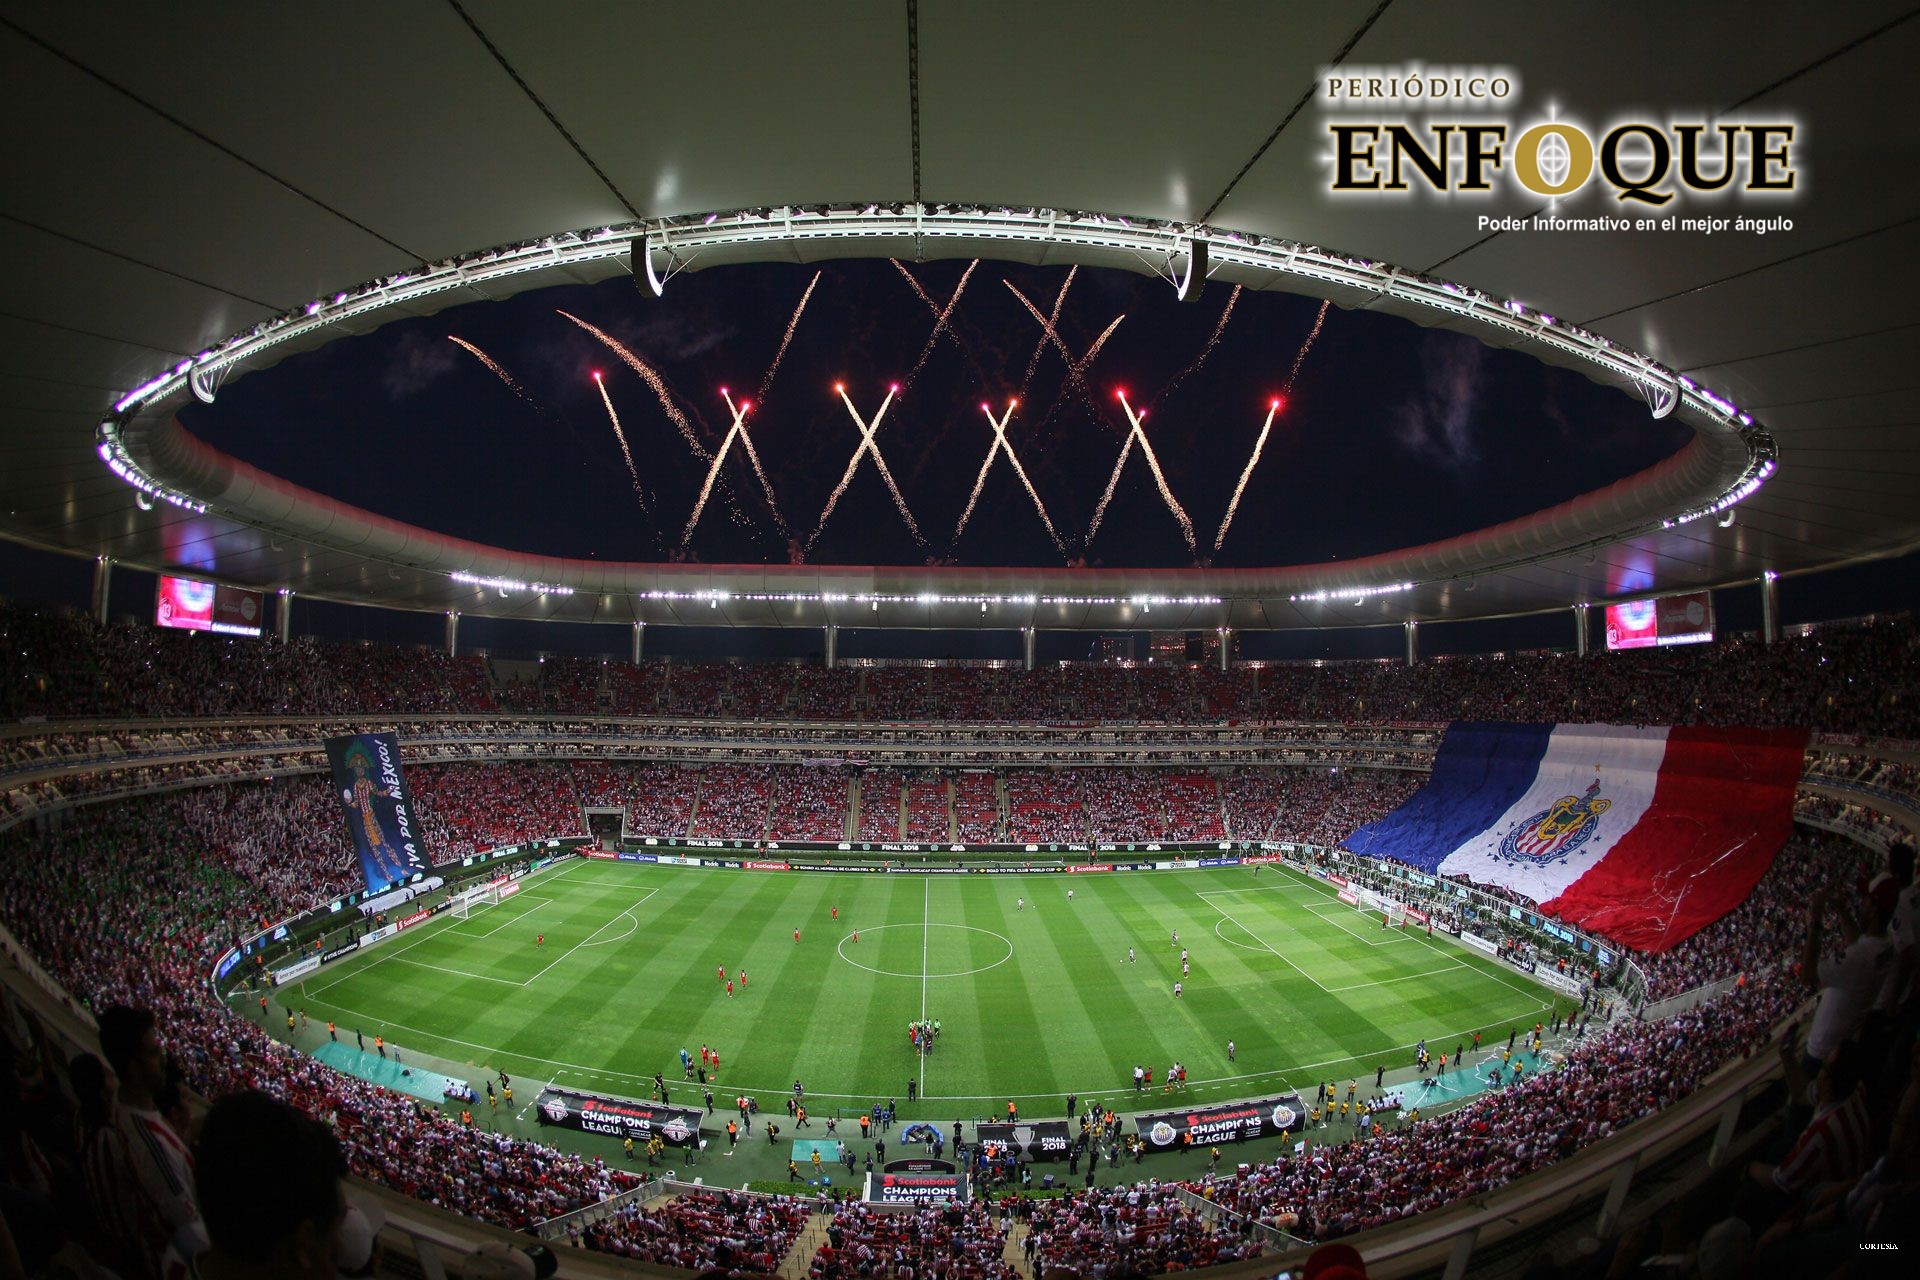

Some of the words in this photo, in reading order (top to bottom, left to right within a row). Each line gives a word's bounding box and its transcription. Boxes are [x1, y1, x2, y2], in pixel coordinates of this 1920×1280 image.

[374, 739, 403, 800] MÉXICO!
[395, 804, 412, 839] POR
[597, 1103, 654, 1119] Scotiabank
[1201, 1109, 1259, 1123] Scotiabank
[1189, 1131, 1237, 1145] LEAGUE
[898, 1178, 957, 1186] Scotiabank
[883, 1187, 957, 1196] CHAMPIONS
